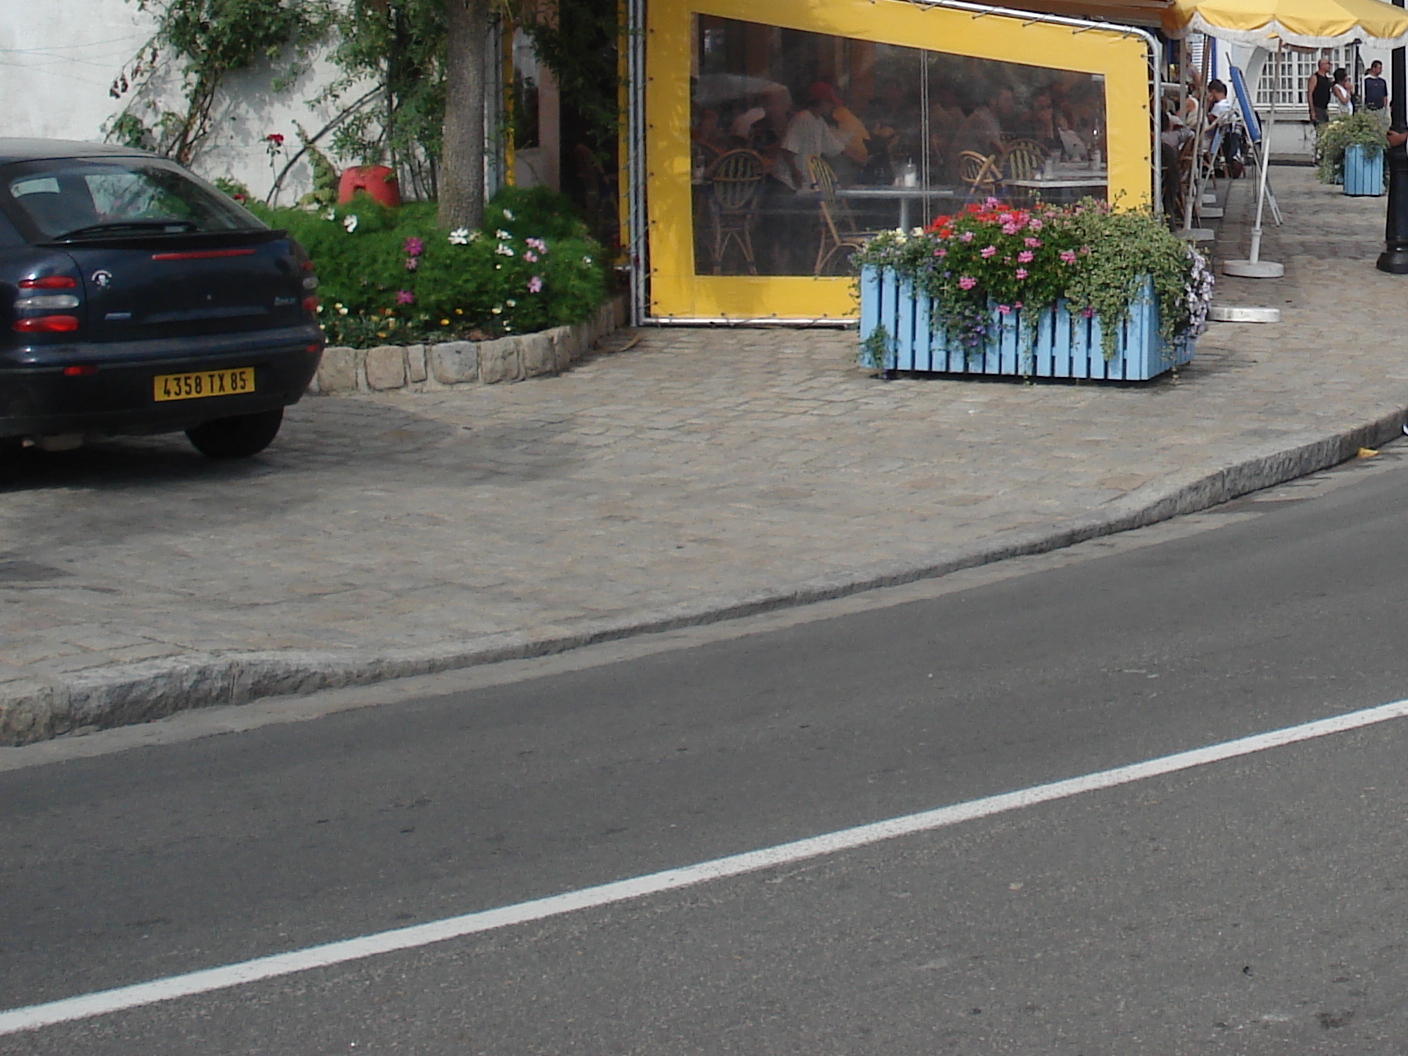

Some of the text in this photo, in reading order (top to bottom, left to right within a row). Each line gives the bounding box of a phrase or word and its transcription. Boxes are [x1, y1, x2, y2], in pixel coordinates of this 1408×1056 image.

[163, 371, 247, 397] 4358 TX 85
